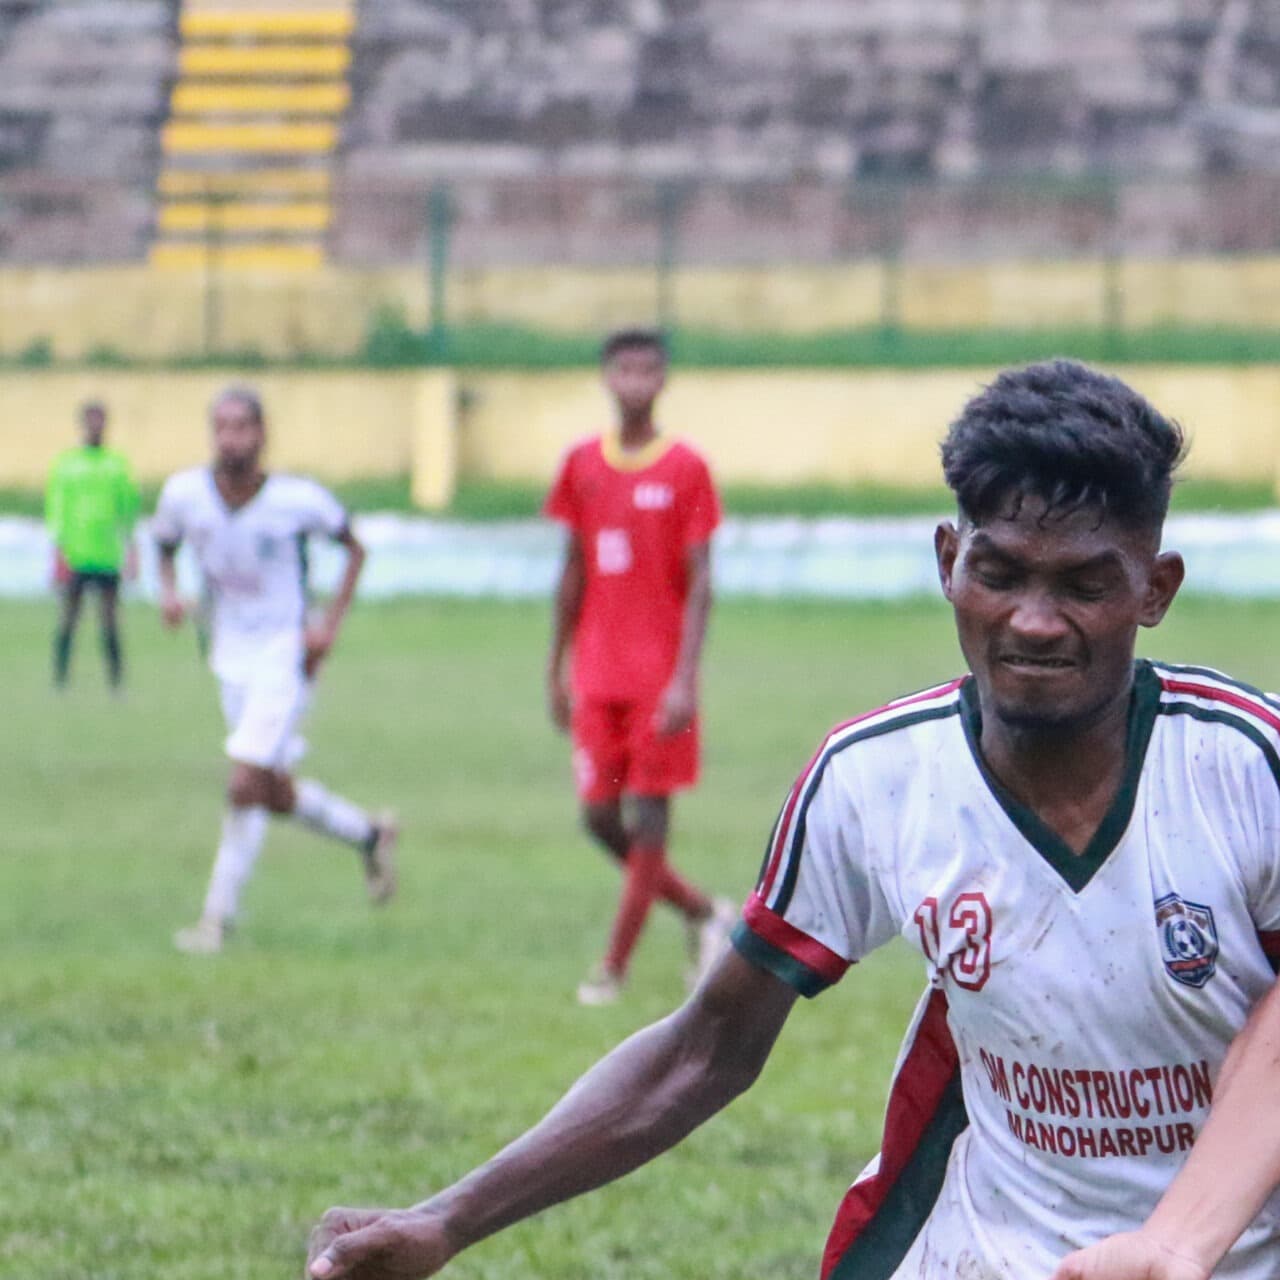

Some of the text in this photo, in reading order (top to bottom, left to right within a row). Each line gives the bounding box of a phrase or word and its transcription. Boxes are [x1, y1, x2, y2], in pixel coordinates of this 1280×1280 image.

[914, 892, 993, 992] 13
[1013, 1060, 1213, 1120] CONSTRUCTION
[1006, 1108, 1196, 1158] MANOHARPUR
